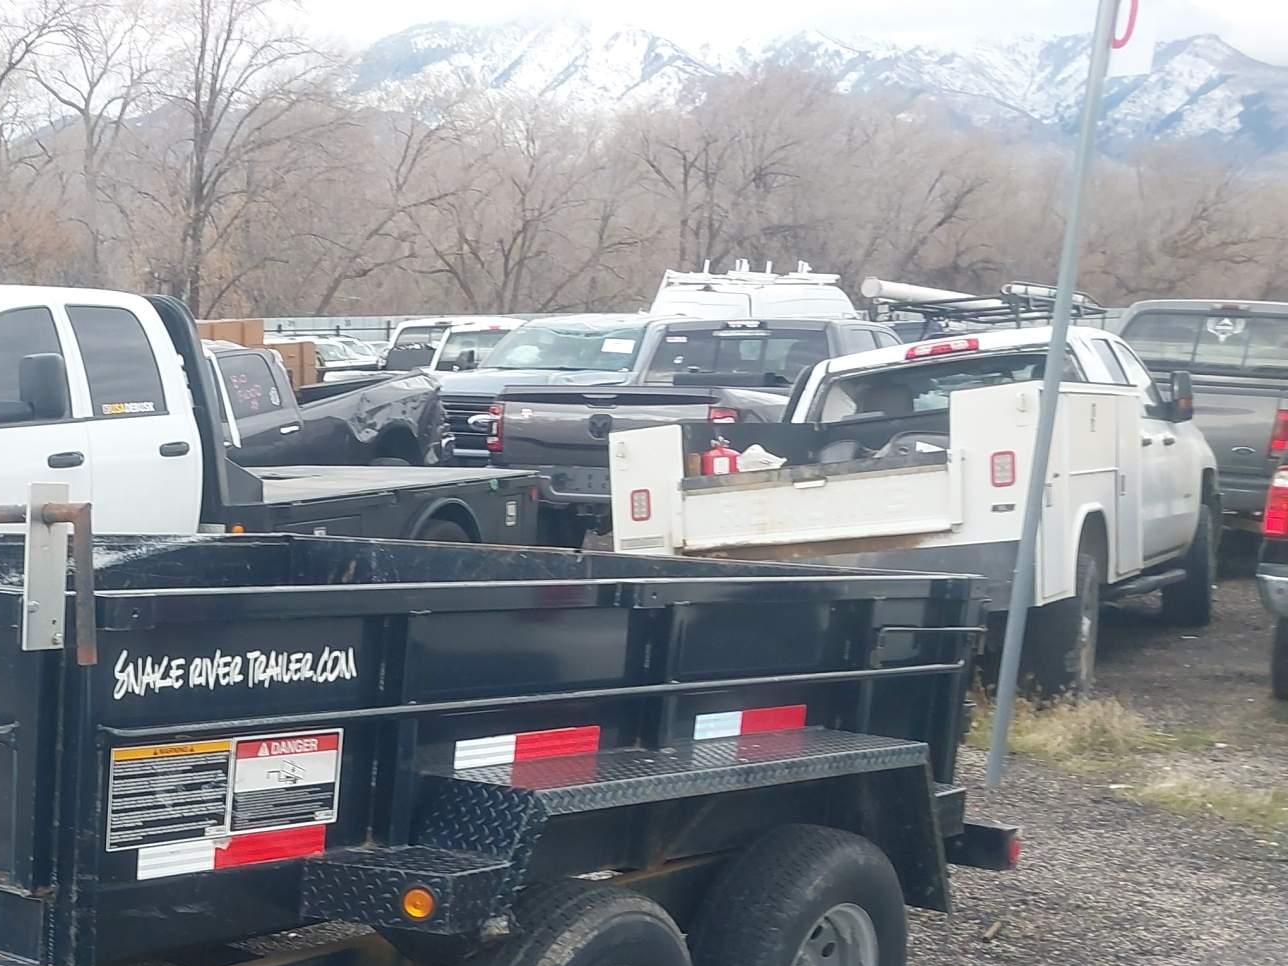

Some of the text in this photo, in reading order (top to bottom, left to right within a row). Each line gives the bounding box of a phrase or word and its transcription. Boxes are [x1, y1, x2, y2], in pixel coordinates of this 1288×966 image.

[113, 646, 358, 700] SNAKE RIVER TRAILER.COM
[271, 738, 318, 755] DANGER
